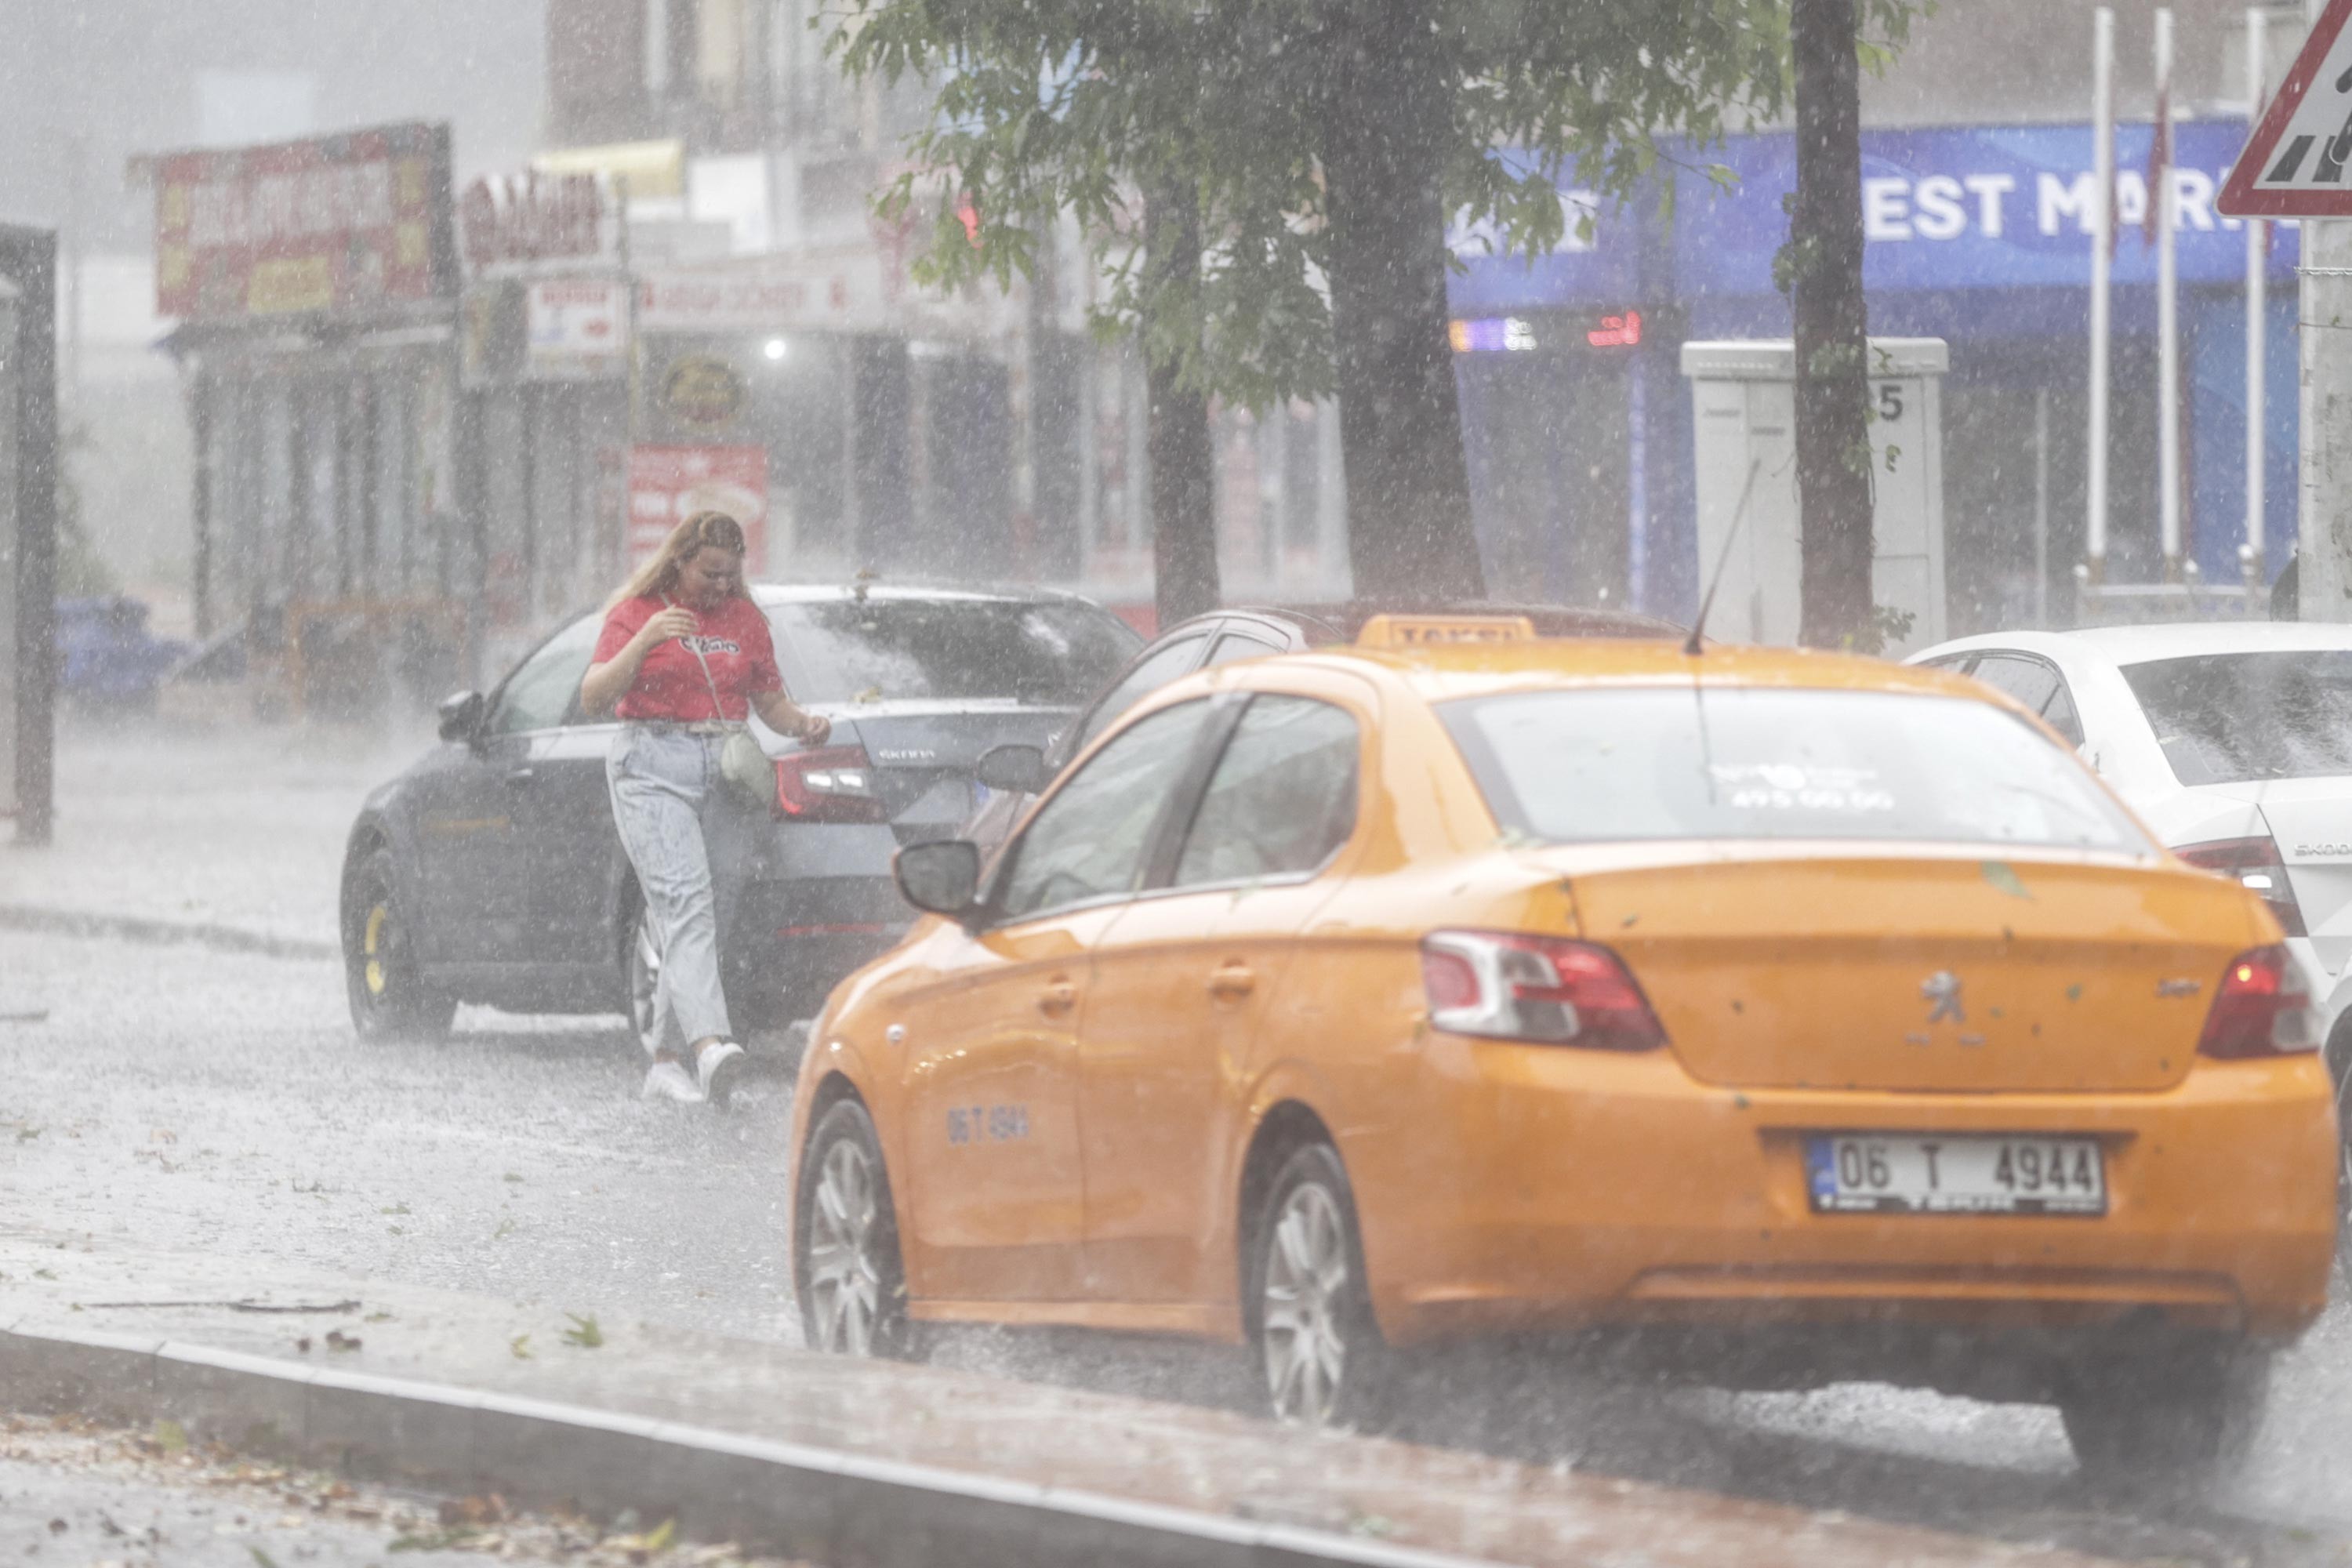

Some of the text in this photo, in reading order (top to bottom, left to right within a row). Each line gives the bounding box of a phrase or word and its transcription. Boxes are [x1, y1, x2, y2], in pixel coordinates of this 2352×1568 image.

[1862, 168, 2301, 240] EST MAR
[2294, 842, 2352, 856] SKOD
[1838, 1142, 2093, 1191] 06 T 4944
